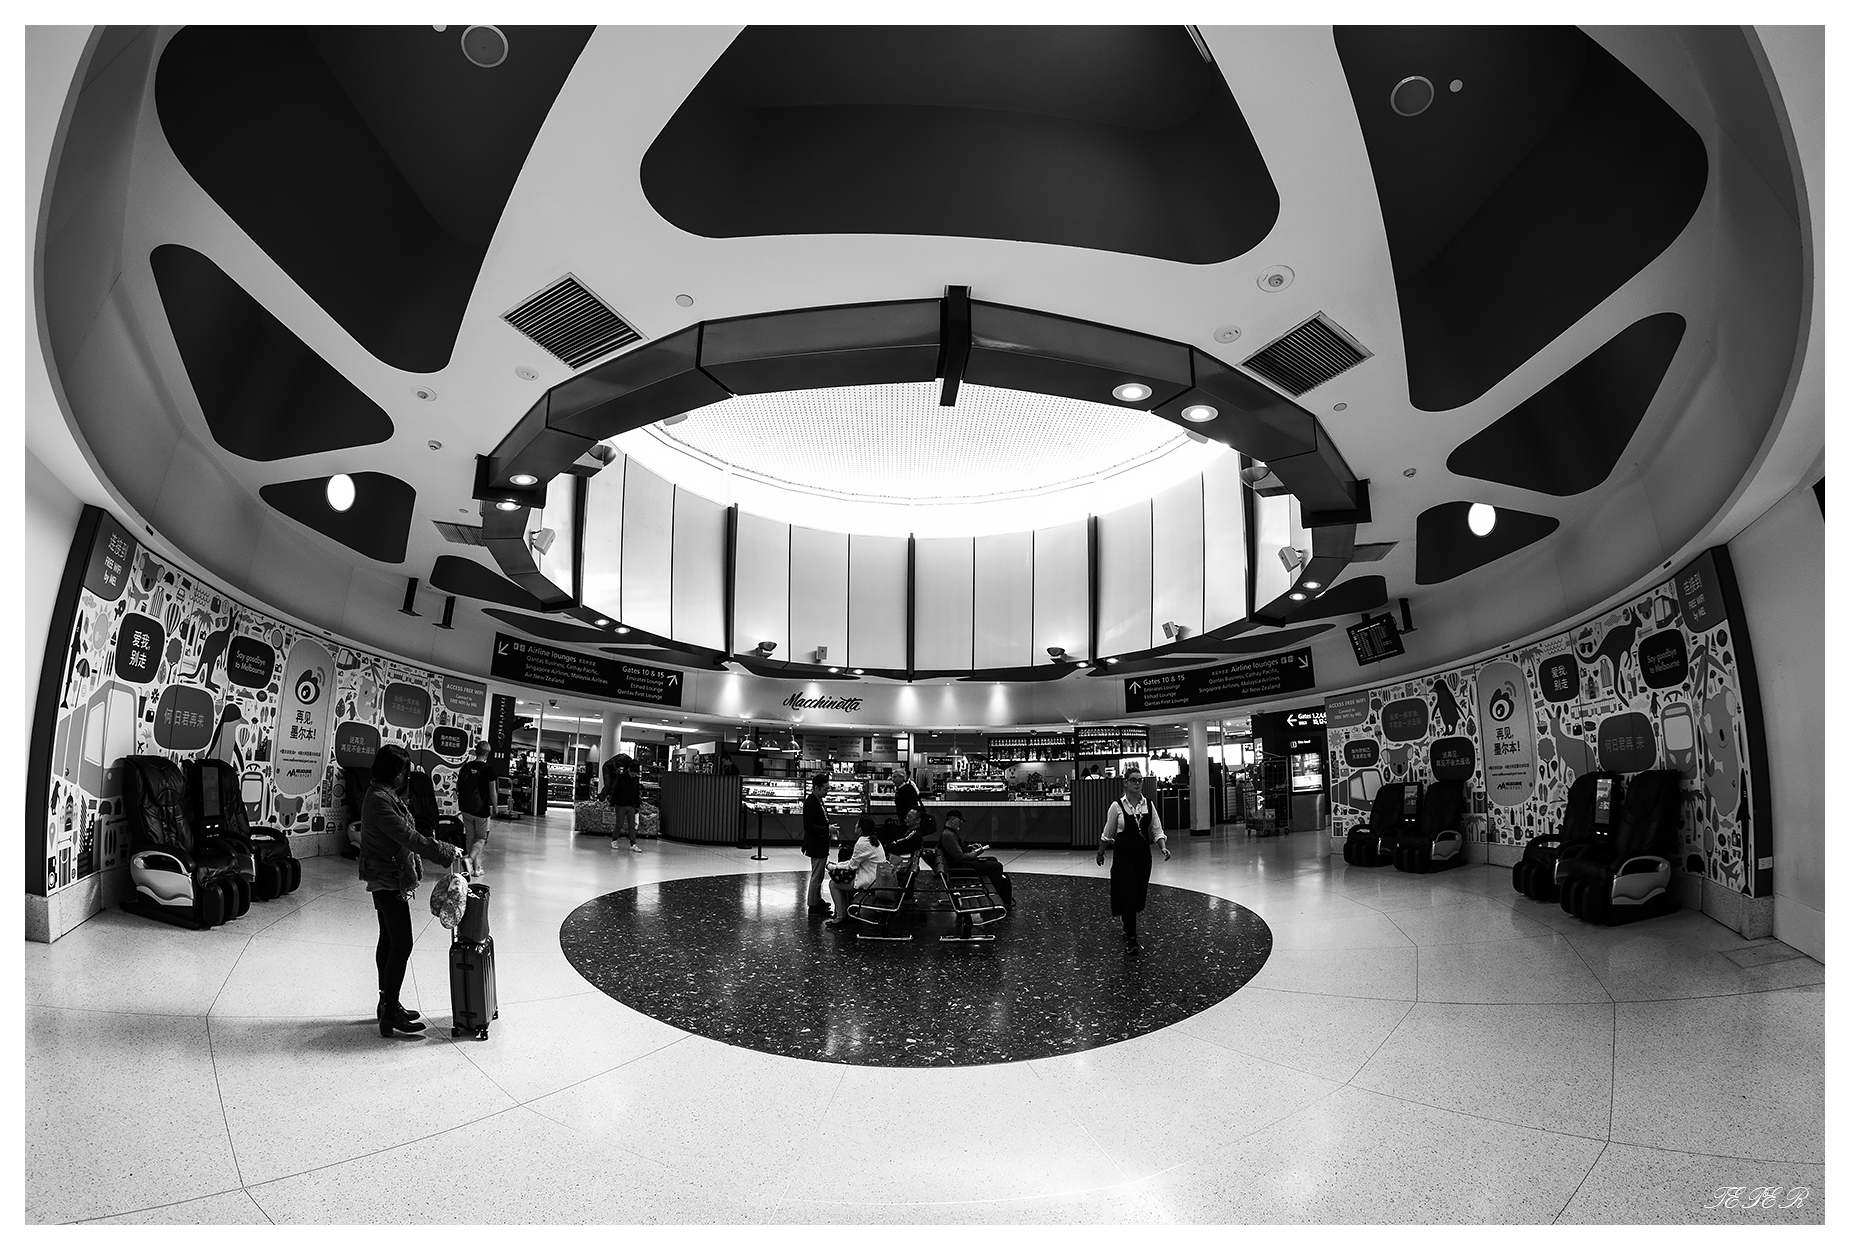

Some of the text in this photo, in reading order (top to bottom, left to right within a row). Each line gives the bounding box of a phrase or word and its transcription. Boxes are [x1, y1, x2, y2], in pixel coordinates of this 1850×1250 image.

[104, 556, 115, 570] FREE
[103, 570, 110, 584] by
[1688, 598, 1698, 610] FREE
[1692, 611, 1699, 621] by
[129, 650, 147, 669] 别走
[235, 650, 266, 667] Say goodbye
[528, 646, 551, 658] Airline
[551, 651, 577, 664] lounges
[1646, 648, 1677, 665] Say goodbye
[234, 661, 266, 676] to Melbourne
[527, 655, 599, 676] Qantas Business, Cathay Pacific,
[622, 665, 641, 675] Gates
[642, 668, 650, 676] 10
[658, 671, 665, 679] 15
[1231, 664, 1252, 673] Airline
[1252, 659, 1279, 670] lounges
[1649, 660, 1680, 674] to Melbourne
[525, 671, 533, 679] Air
[546, 676, 565, 685] Zealand
[526, 663, 609, 685] Singapore Airlines, Malaysia Airlines
[626, 674, 664, 687] Emirates Lounge
[1143, 678, 1161, 686] Gates
[1170, 675, 1176, 683] &
[1177, 674, 1186, 682] 15
[1208, 667, 1280, 685] Qantas Business, Cathay Pacific,
[446, 683, 463, 692] ACCESS
[630, 682, 663, 693] Etihad Lounge
[1198, 675, 1281, 694] Singapore Airlines, Malaysia Airlines
[1261, 682, 1281, 691] Zealand
[1553, 678, 1569, 691] 别走
[617, 688, 663, 701] Qantas First Lounge
[1143, 692, 1159, 700] Etihad
[783, 691, 863, 713] Macchinetta
[1328, 701, 1345, 709] ACCESS
[164, 707, 204, 728] 何日君再来
[1605, 734, 1645, 753] 何日君再来
